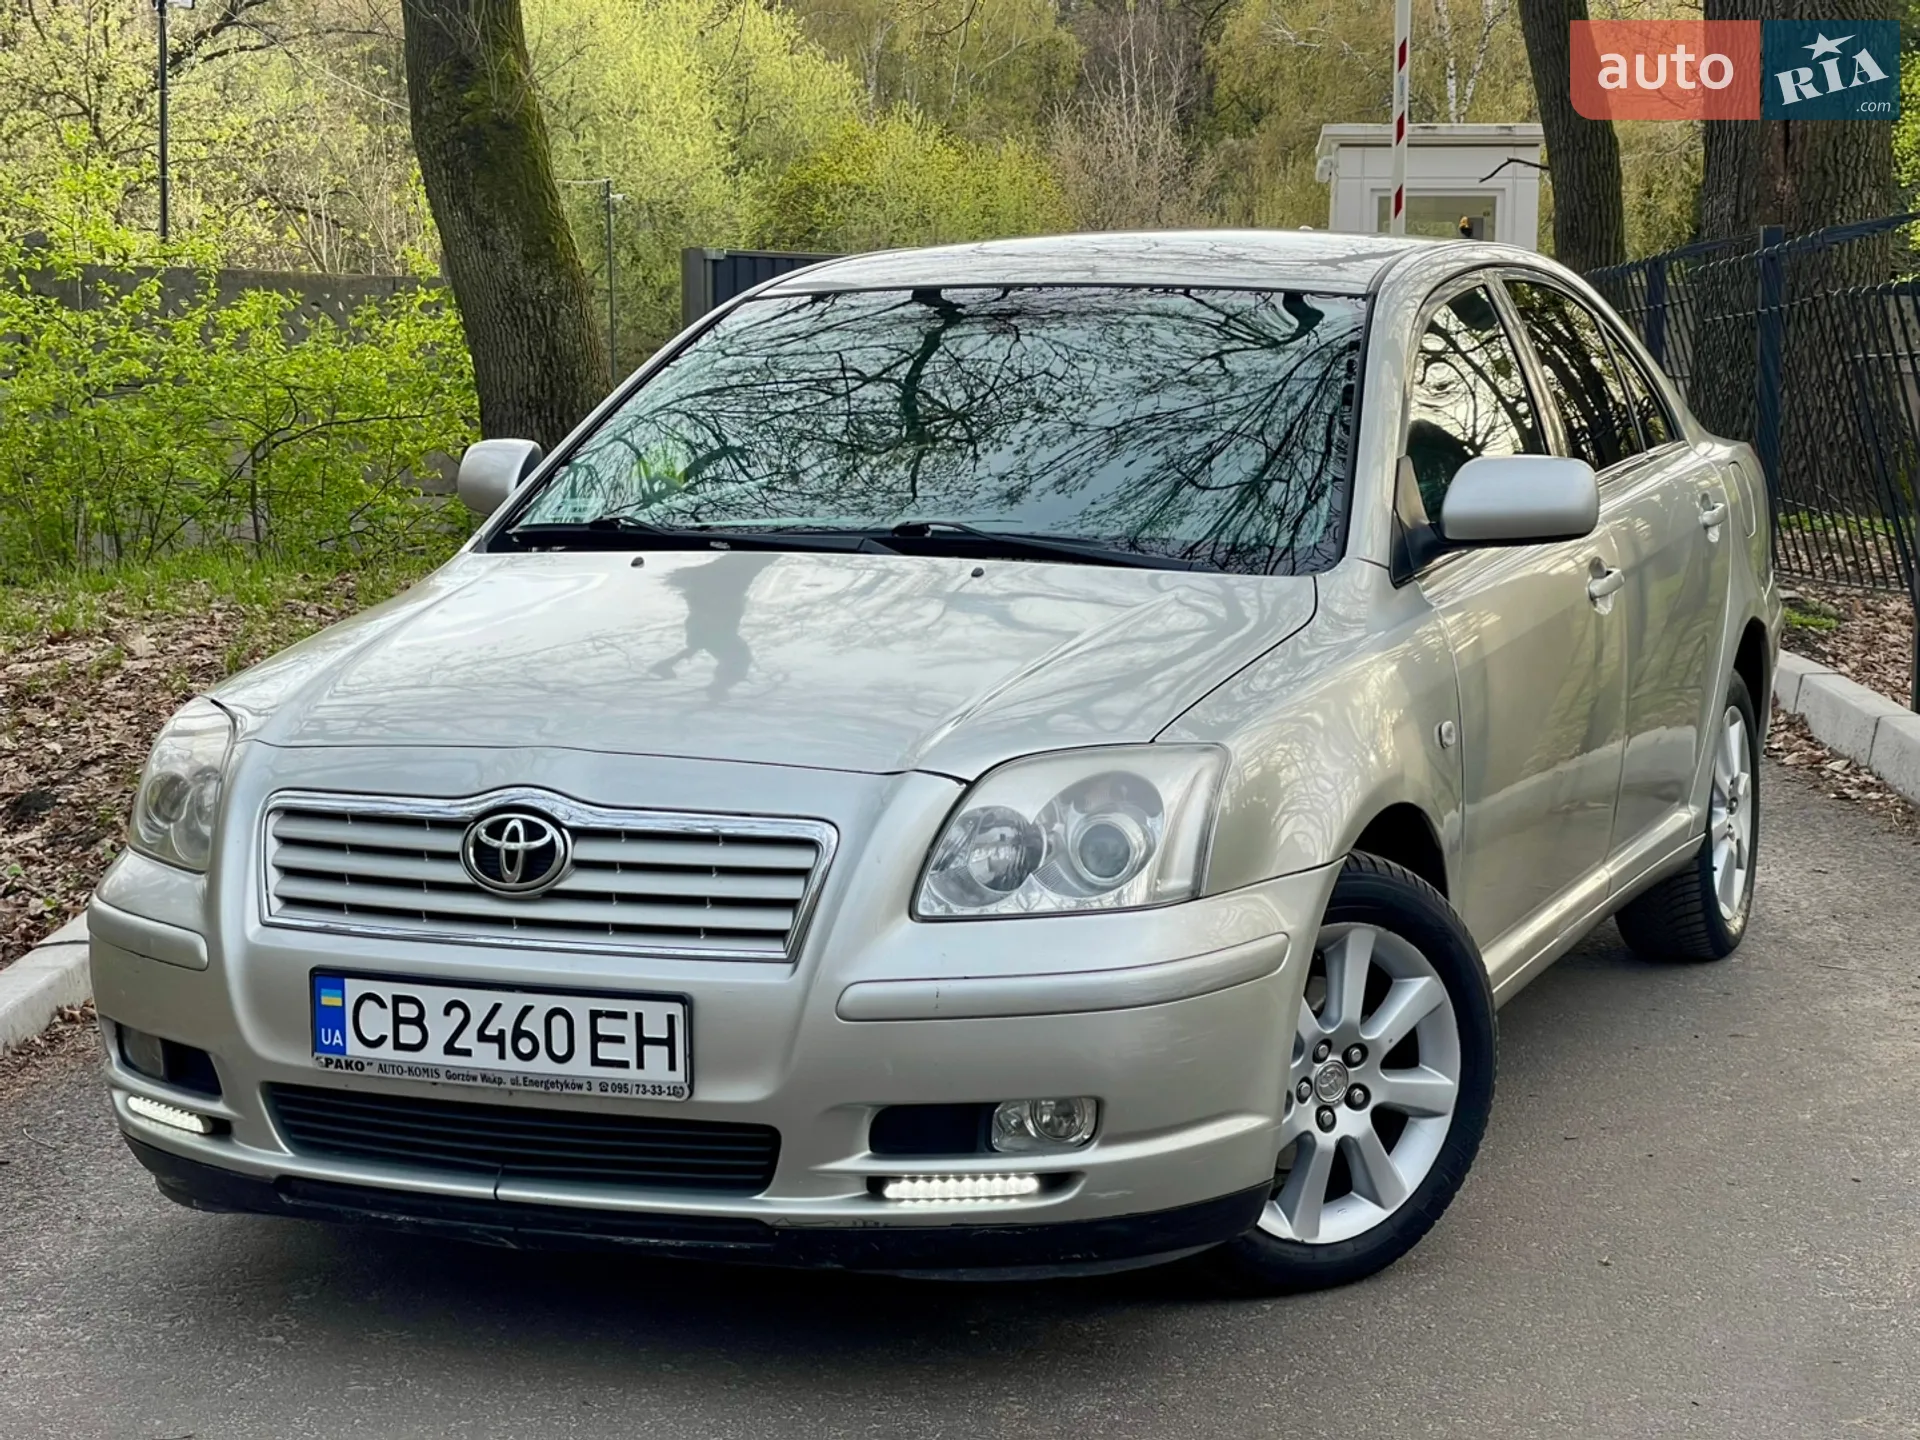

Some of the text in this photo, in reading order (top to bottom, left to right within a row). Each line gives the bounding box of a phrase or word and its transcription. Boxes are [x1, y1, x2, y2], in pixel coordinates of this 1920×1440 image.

[321, 1028, 344, 1047] UA
[352, 992, 677, 1071] CB 2460 EH
[377, 1063, 440, 1079] AUTO-KOMIS
[586, 1080, 593, 1092] 3
